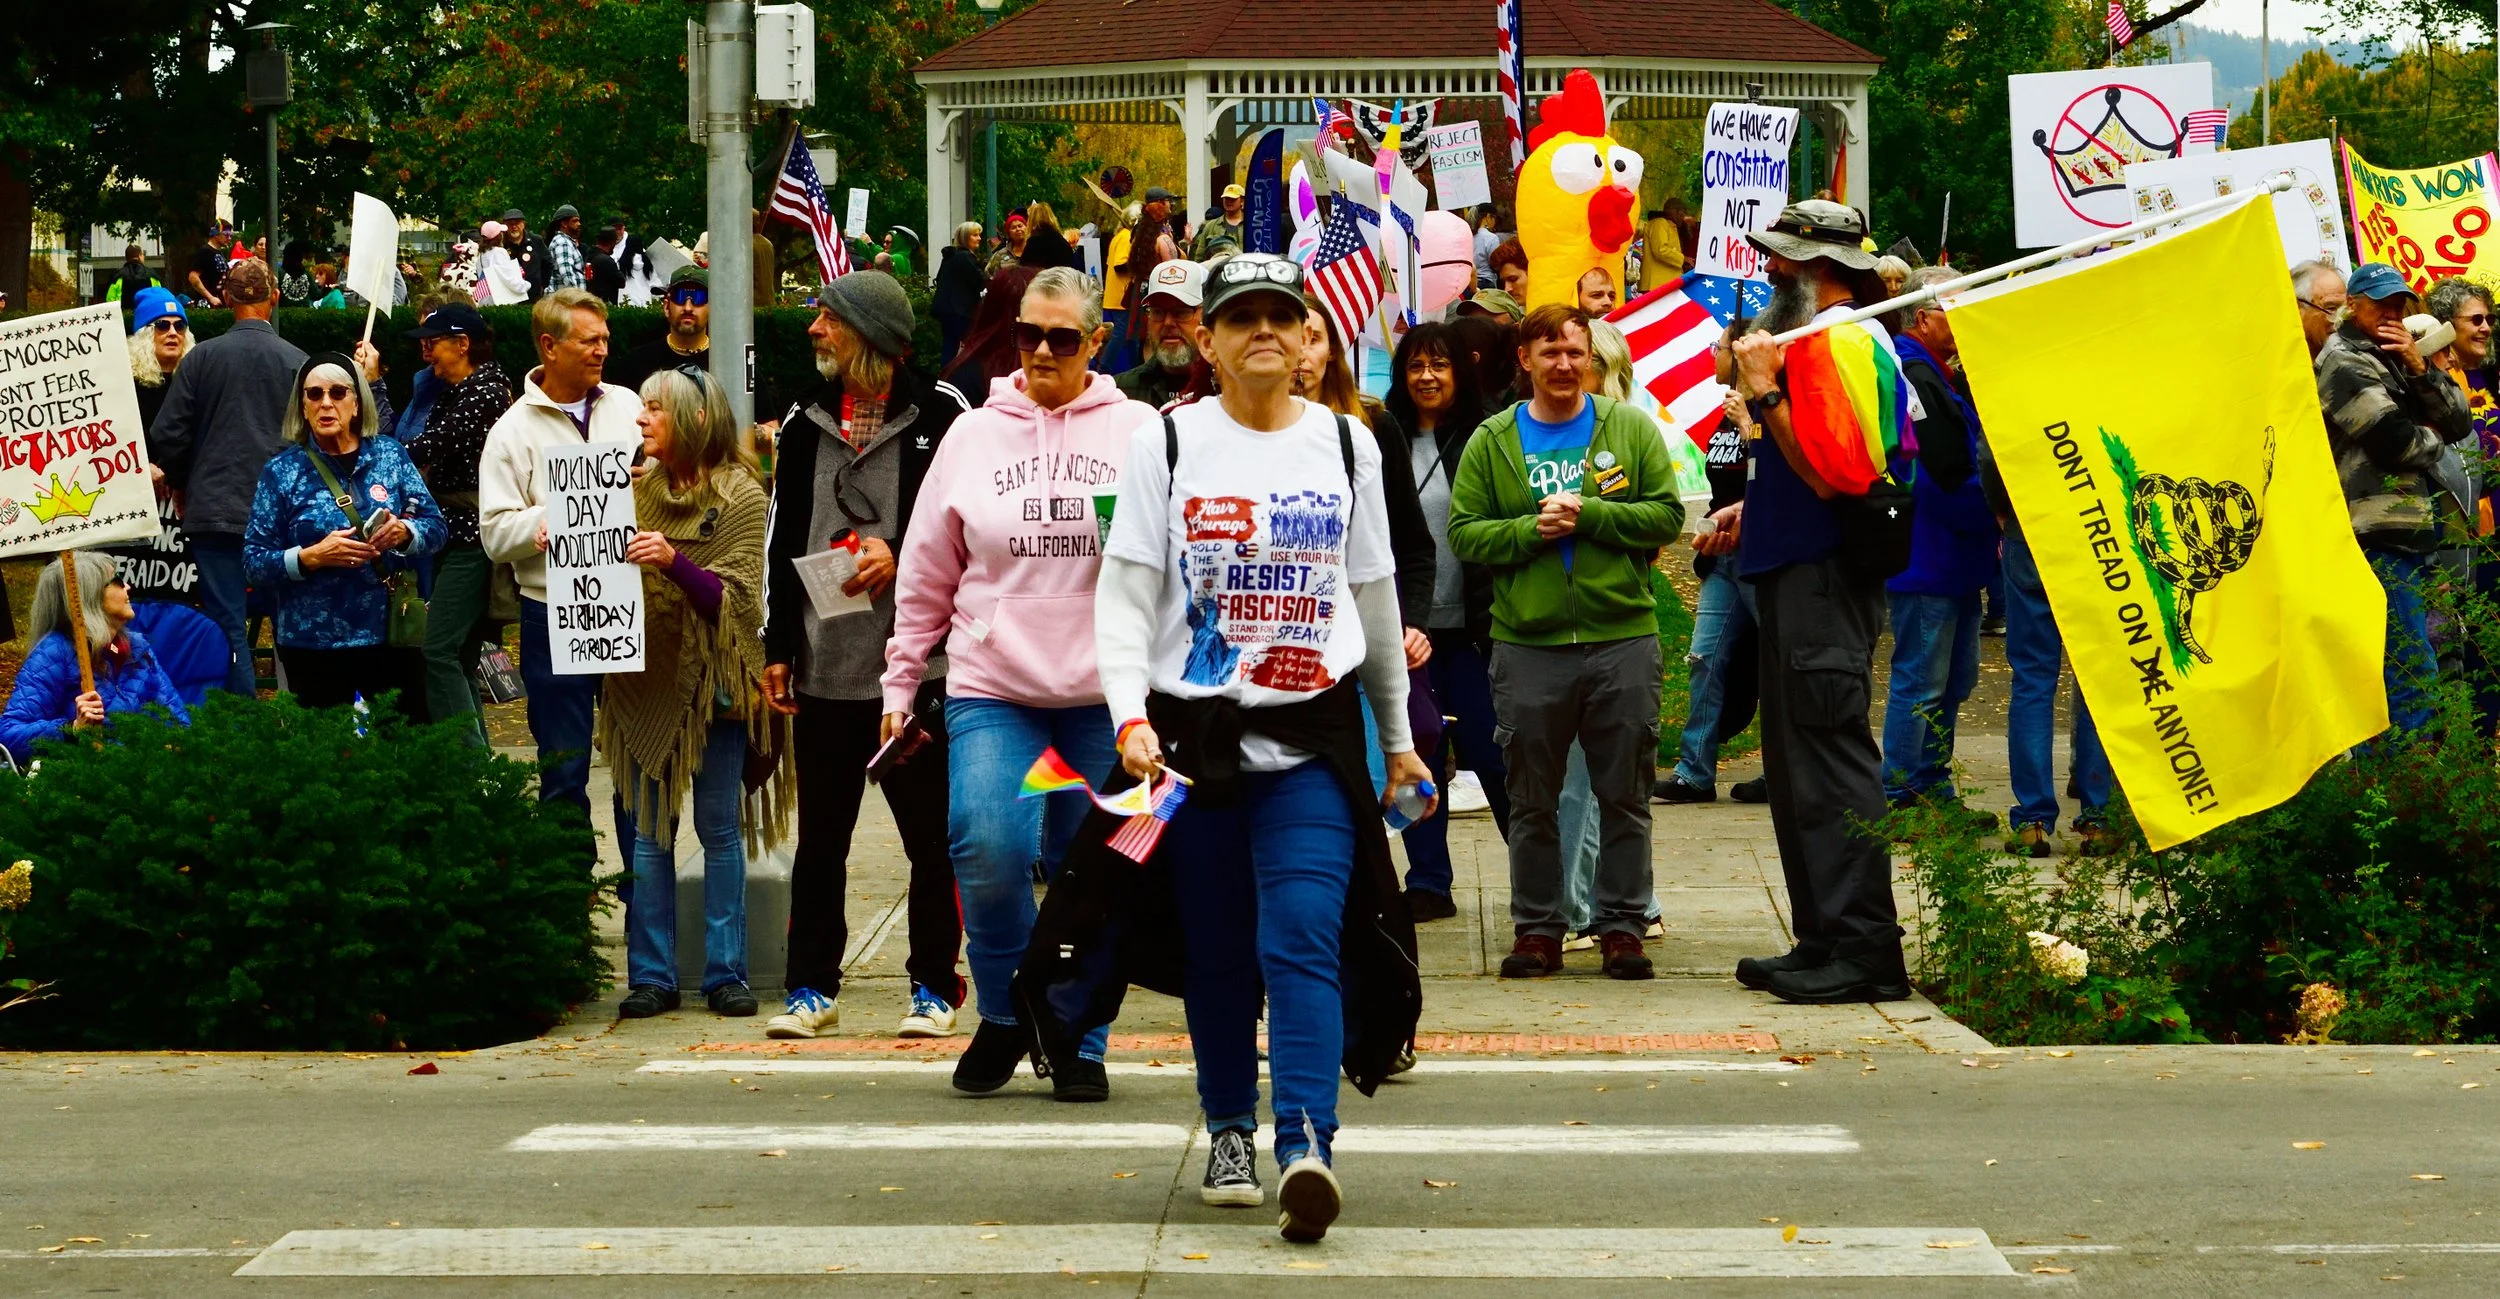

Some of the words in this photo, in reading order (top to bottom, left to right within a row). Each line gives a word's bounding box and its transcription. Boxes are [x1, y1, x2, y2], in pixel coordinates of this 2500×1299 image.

[1428, 126, 1479, 149] REJECT
[1431, 149, 1483, 170] FASCISM
[2348, 151, 2408, 207] HARRIS
[2410, 158, 2485, 203] WON
[1723, 198, 1761, 232] NOT
[2358, 202, 2398, 256] LETS
[1709, 235, 1719, 262] a
[2387, 235, 2425, 282] GO
[0, 328, 103, 373] EMOCRACY
[43, 369, 97, 398] FEAR
[0, 419, 118, 475] ICTATORS
[1705, 446, 1739, 463] MAGA
[88, 441, 143, 485] DO!
[994, 460, 1026, 496] SAN
[566, 493, 609, 529] DAY
[1025, 499, 1041, 519] ES
[1055, 499, 1082, 519] 1850
[1197, 500, 1238, 516] Have
[1188, 516, 1249, 536] Courage
[1009, 535, 1097, 558] CALIFORNIA
[1190, 543, 1223, 553] HOLD
[1193, 555, 1214, 565] THE
[1270, 551, 1291, 562] USE
[1294, 551, 1322, 563] YOUR
[113, 555, 171, 589] FRAID
[171, 562, 199, 593] OF
[1193, 567, 1220, 577] LINE
[1226, 564, 1312, 591] RESIST
[573, 574, 602, 601] NO
[556, 601, 636, 631] BIRTHDAY
[1217, 593, 1317, 624] FASCISM
[2043, 420, 2095, 492] DONT
[2079, 497, 2131, 592] TREAD
[2118, 601, 2152, 647] ON
[2149, 703, 2220, 816] ANYONE!
[1225, 634, 1277, 644] DEMOCRACY
[1229, 623, 1258, 634] STAND
[1259, 624, 1275, 634] FOR
[1276, 625, 1321, 643] SPEAK
[568, 633, 641, 663] PARADES!
